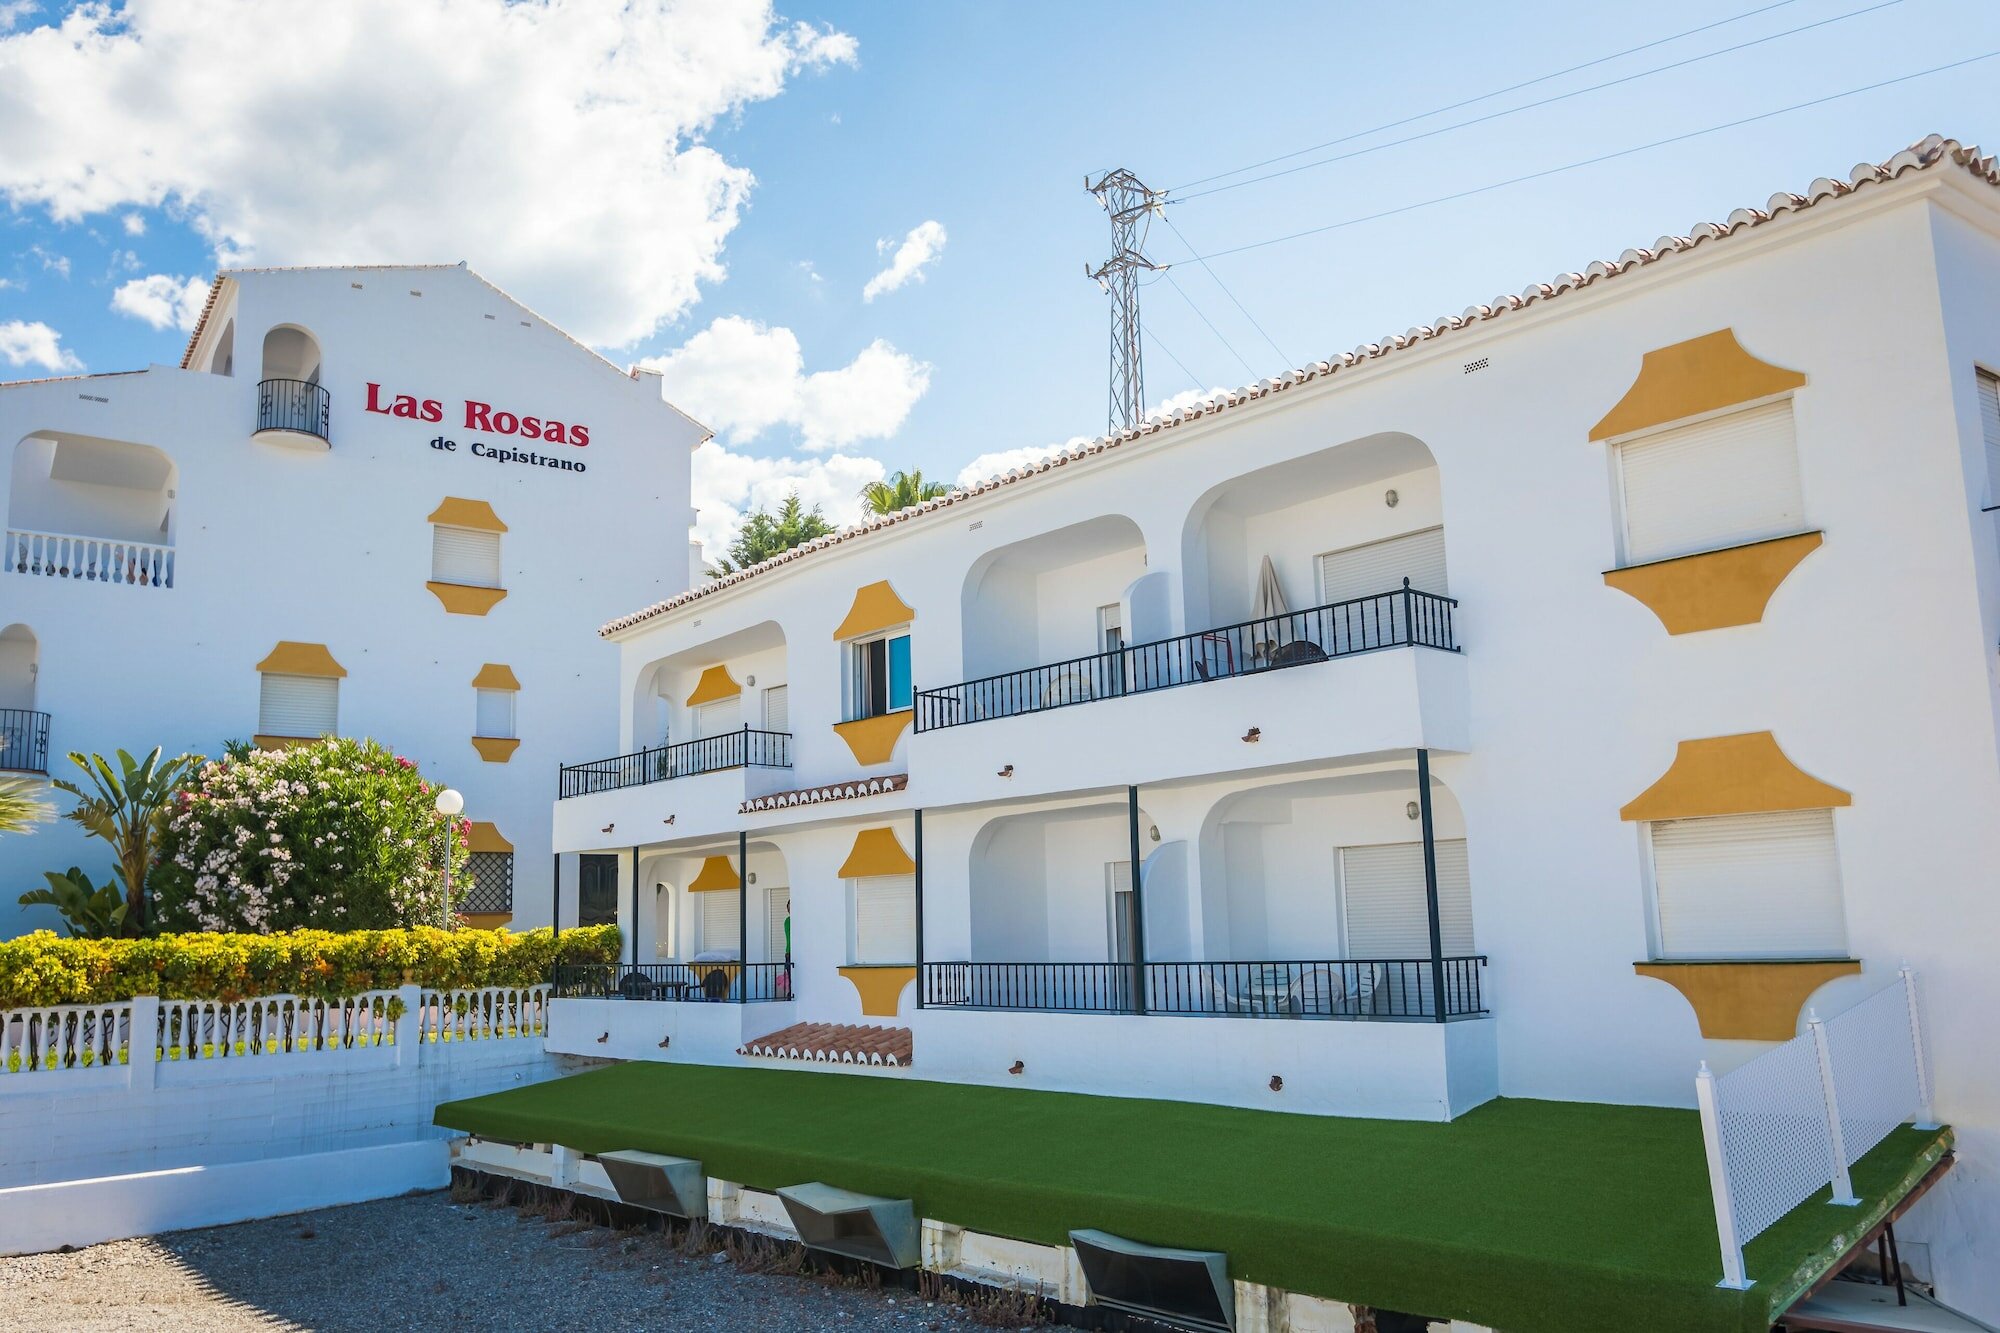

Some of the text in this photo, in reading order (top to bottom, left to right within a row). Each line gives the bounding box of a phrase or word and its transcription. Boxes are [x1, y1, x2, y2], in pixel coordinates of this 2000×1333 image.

[365, 382, 590, 447] Las Rosas
[430, 436, 586, 473] de Capistrano
